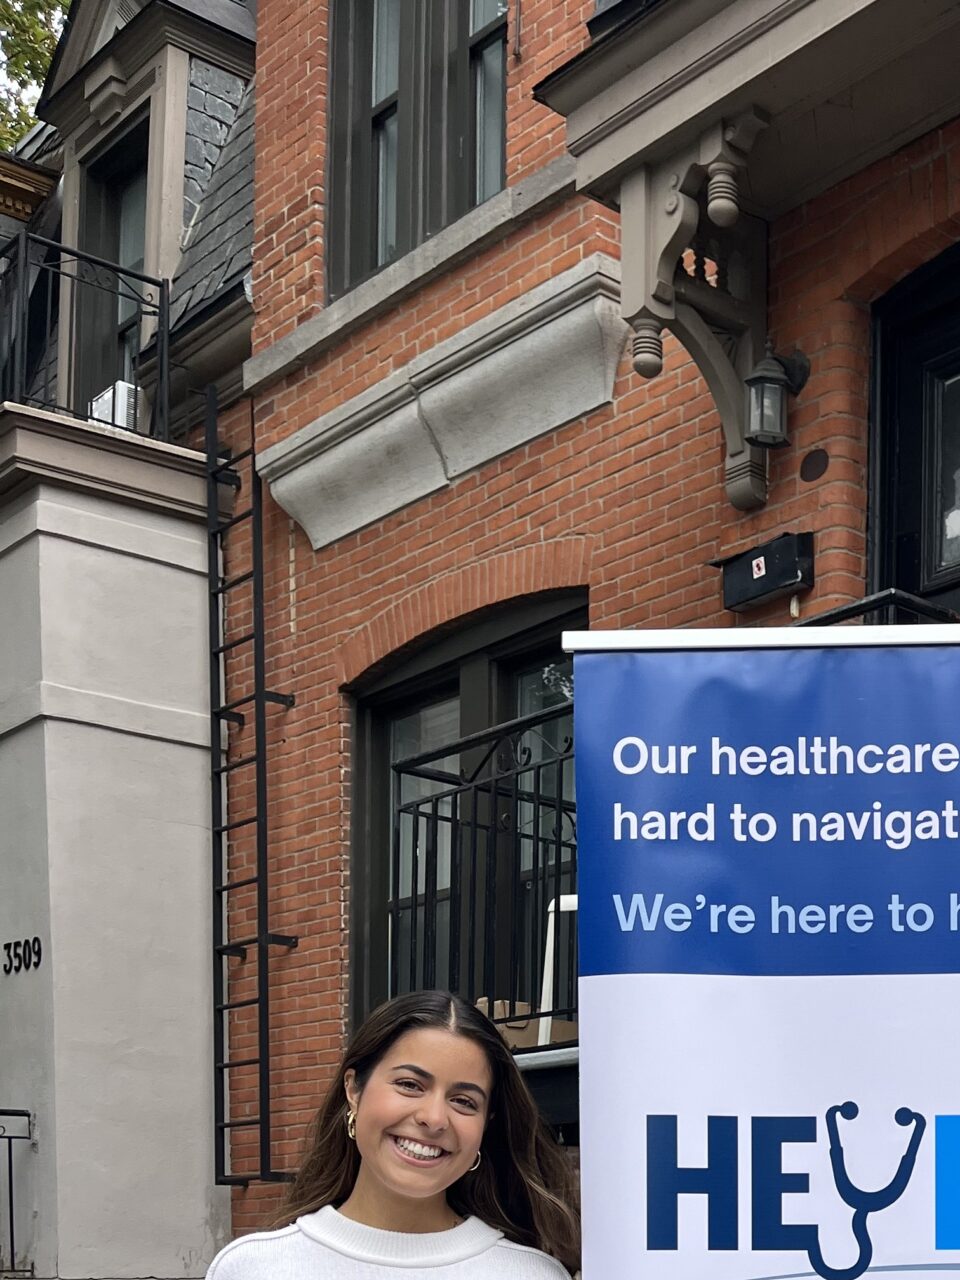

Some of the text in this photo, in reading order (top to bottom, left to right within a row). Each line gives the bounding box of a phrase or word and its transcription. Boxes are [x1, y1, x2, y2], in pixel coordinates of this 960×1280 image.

[613, 737, 696, 774] Our
[712, 737, 959, 775] healthcare
[614, 803, 714, 841] hard
[730, 804, 776, 841] to
[613, 894, 755, 933] We’re
[772, 896, 873, 933] here
[888, 895, 934, 931] to
[3, 937, 42, 975] 3509
